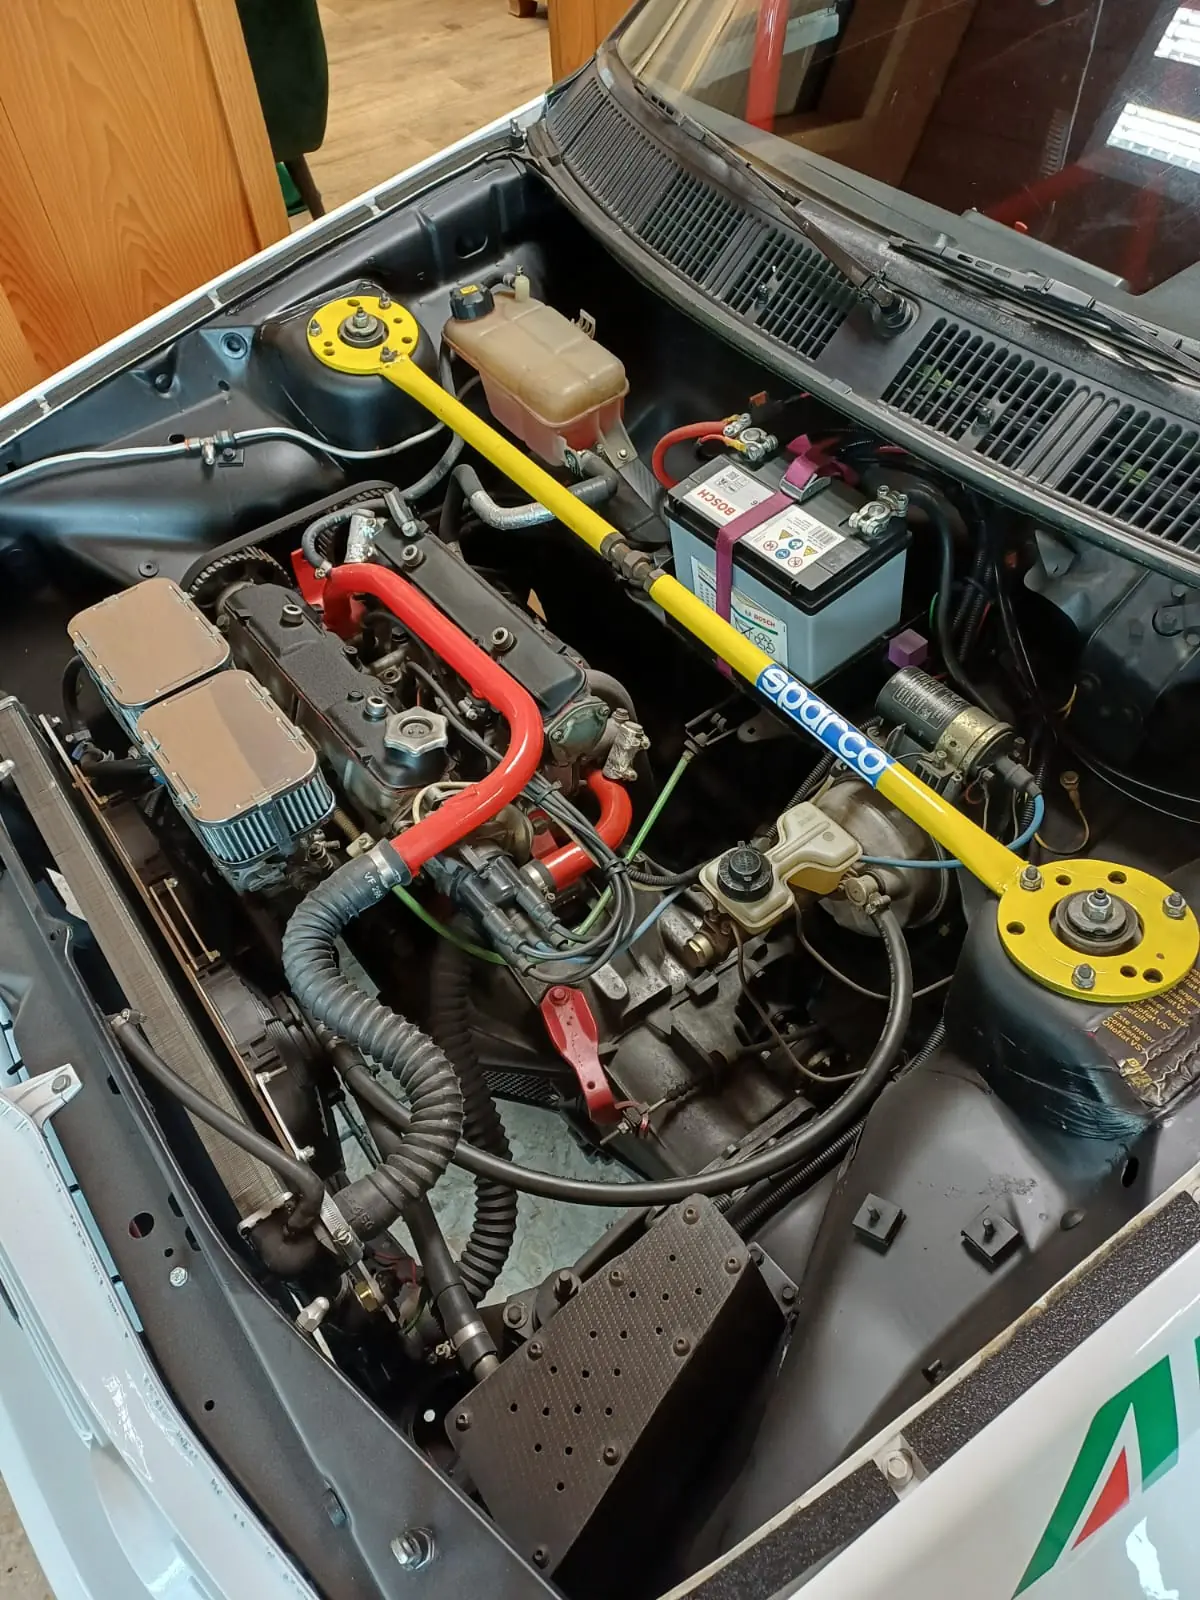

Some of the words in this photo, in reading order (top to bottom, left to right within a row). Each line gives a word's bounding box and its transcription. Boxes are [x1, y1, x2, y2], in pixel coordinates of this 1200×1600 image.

[697, 488, 736, 516] BOSCH
[762, 668, 887, 775] sparco
[364, 871, 377, 884] VF
[1131, 1025, 1156, 1043] motor
